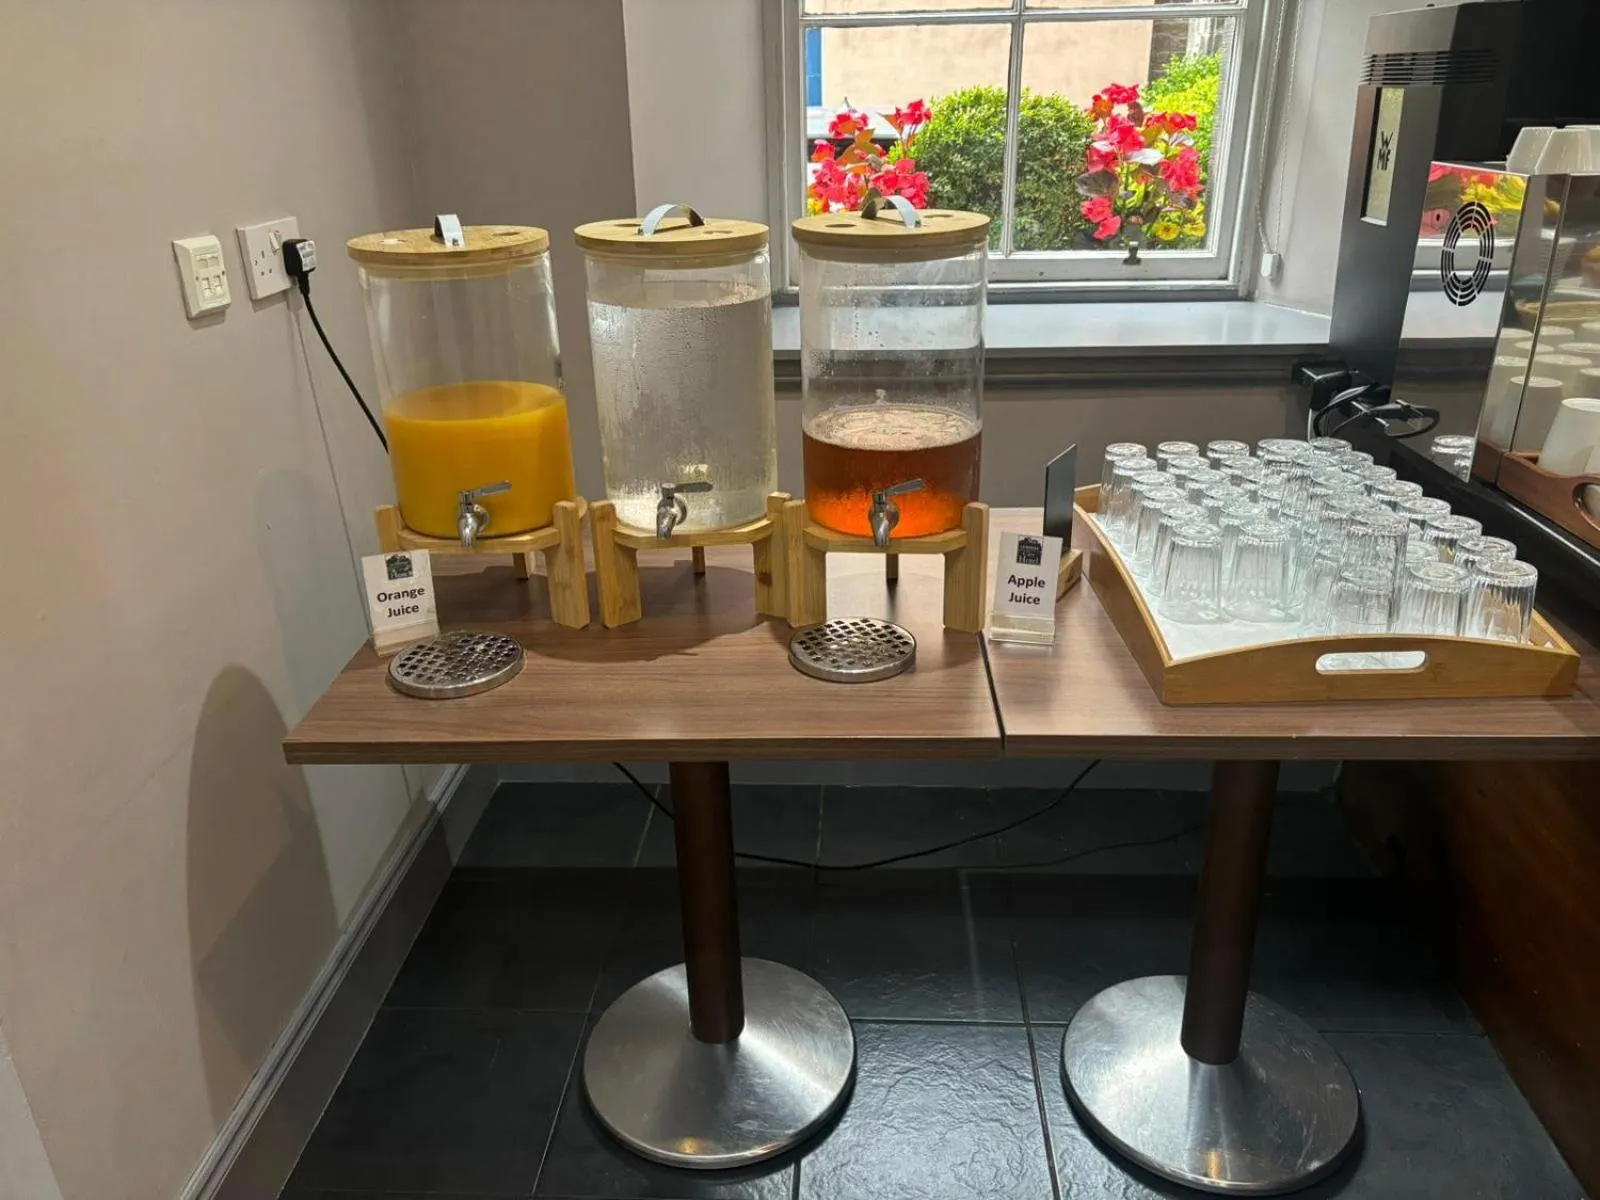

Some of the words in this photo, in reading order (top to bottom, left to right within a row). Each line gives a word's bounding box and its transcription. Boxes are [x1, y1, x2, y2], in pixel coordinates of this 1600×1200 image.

[1008, 574, 1046, 588] Apple
[377, 587, 425, 602] Orange
[1008, 592, 1041, 605] Juice
[387, 604, 420, 618] Juice
